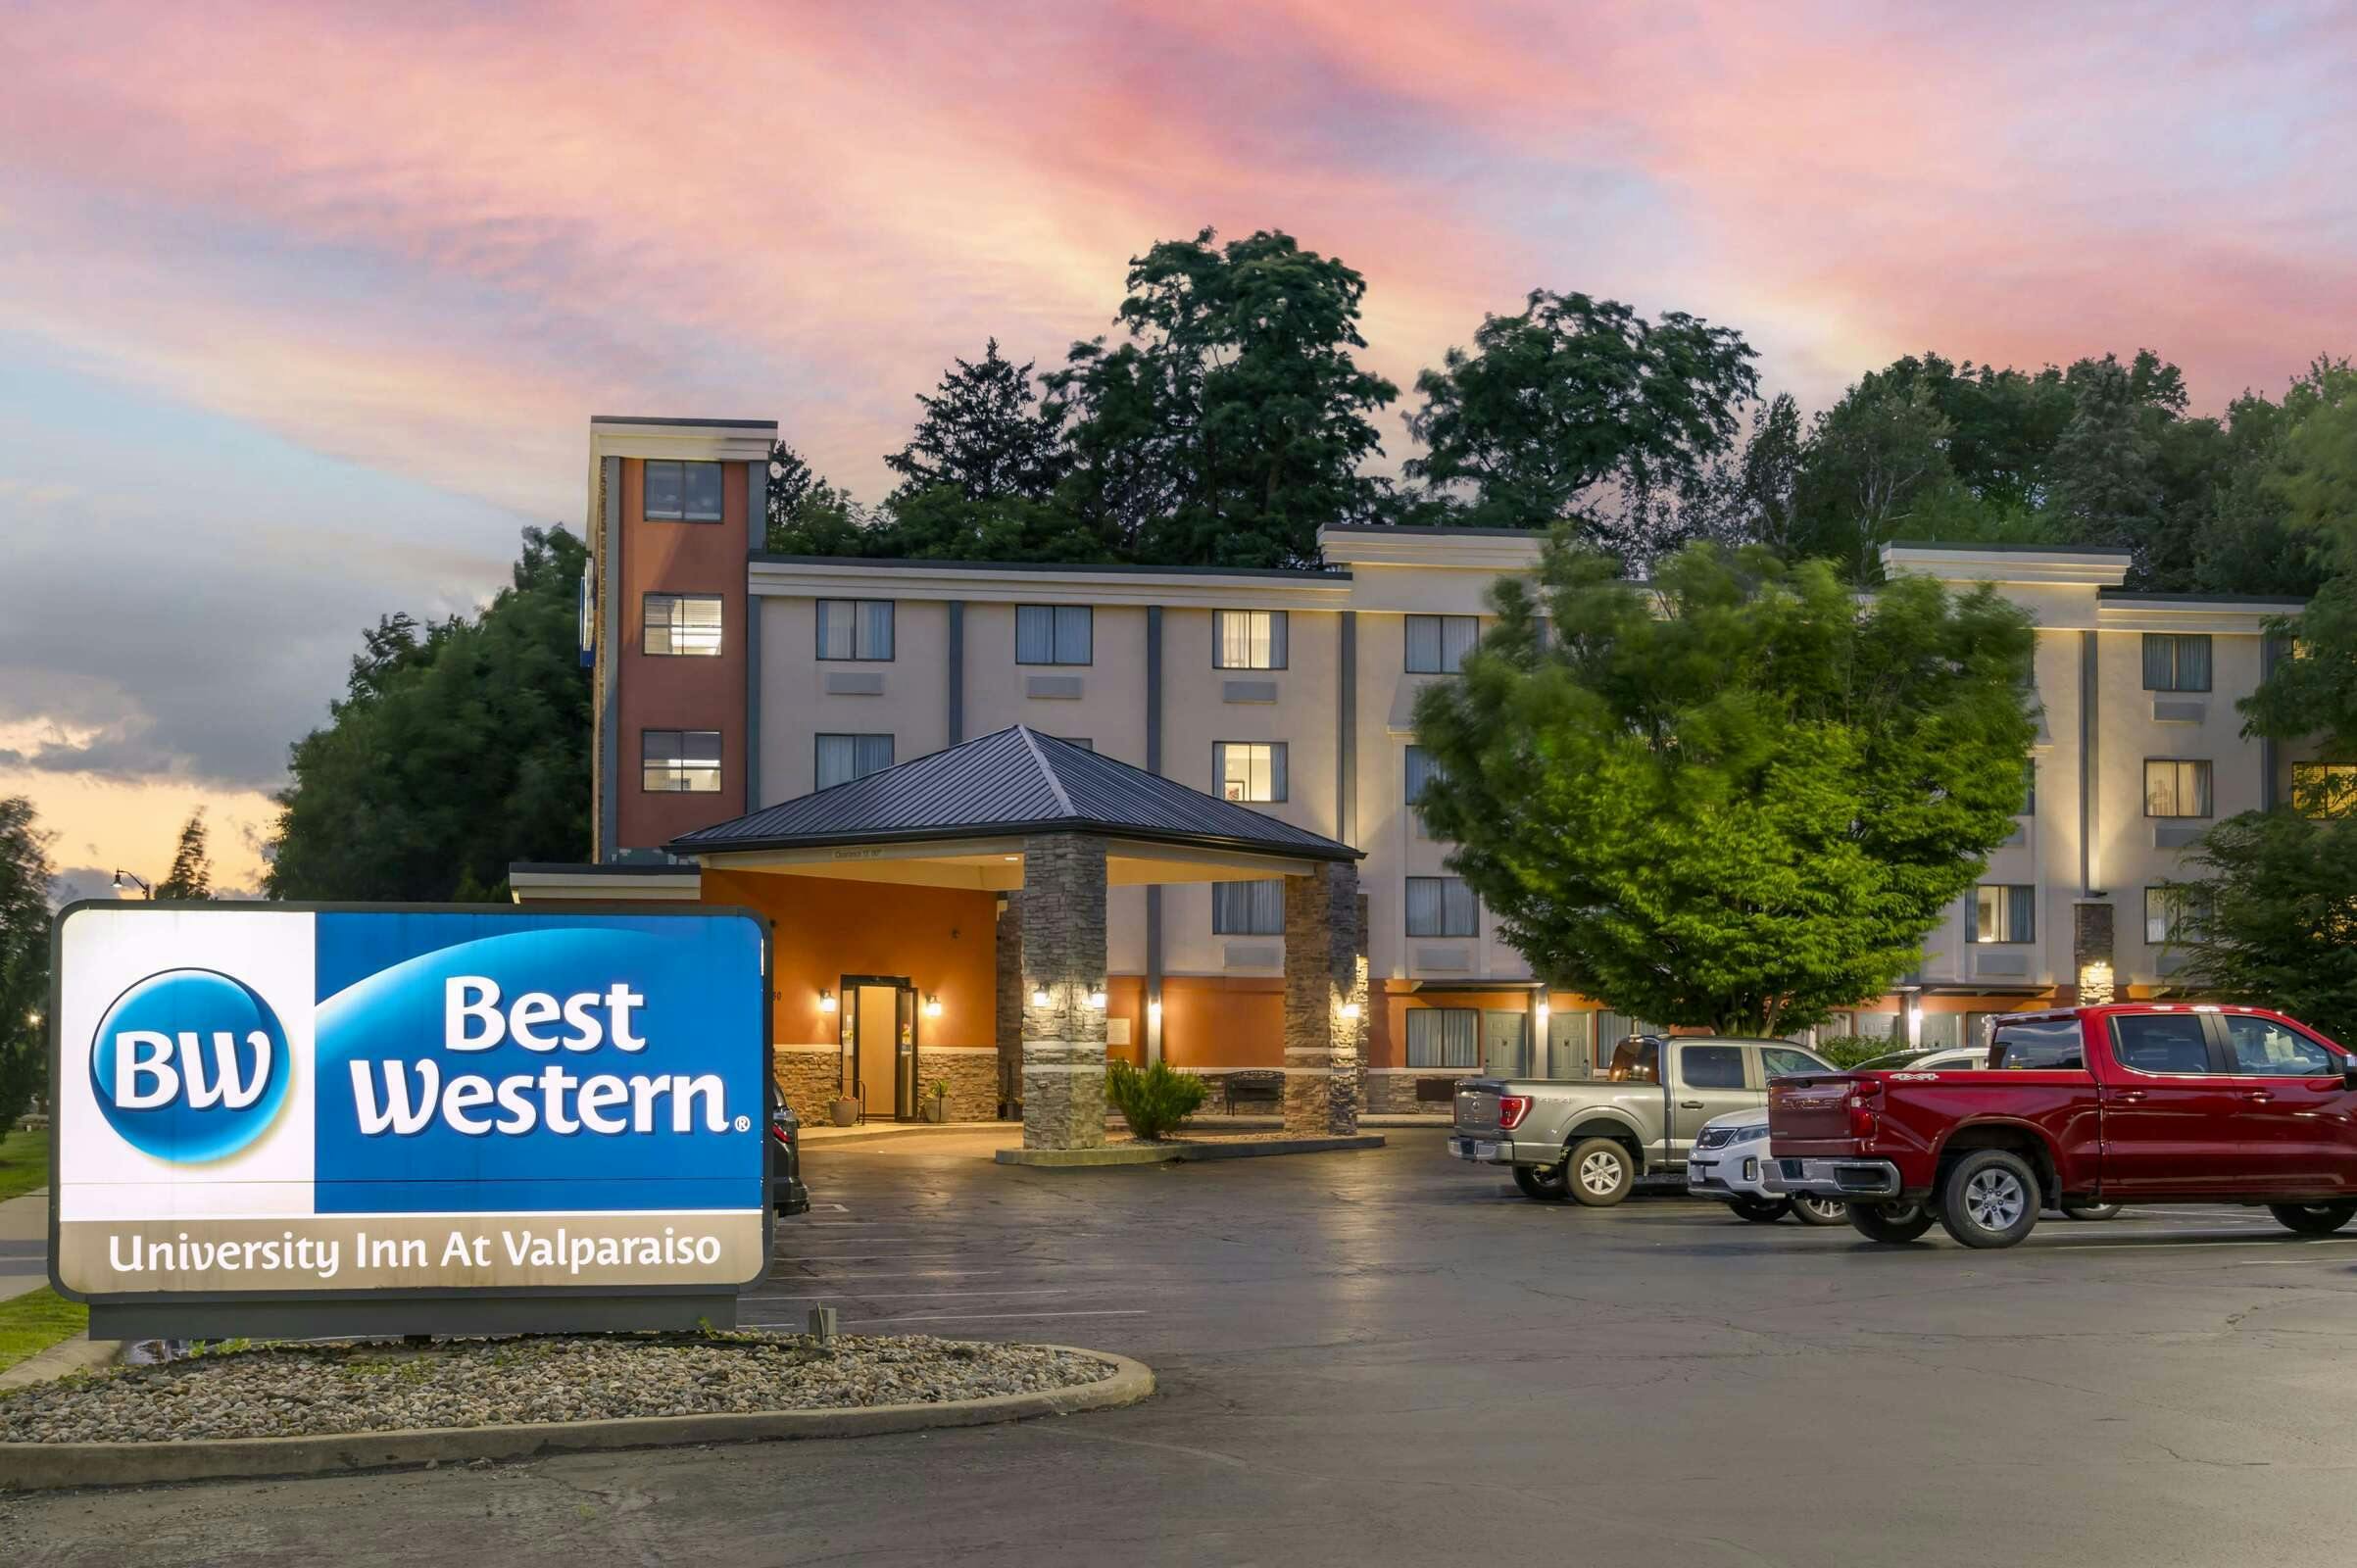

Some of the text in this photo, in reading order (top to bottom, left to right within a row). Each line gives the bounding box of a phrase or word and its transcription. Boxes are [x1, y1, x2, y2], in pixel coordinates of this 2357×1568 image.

[444, 976, 646, 1053] Best
[116, 1031, 270, 1110] BW
[109, 1226, 722, 1279] University Inn At Valparaiso
